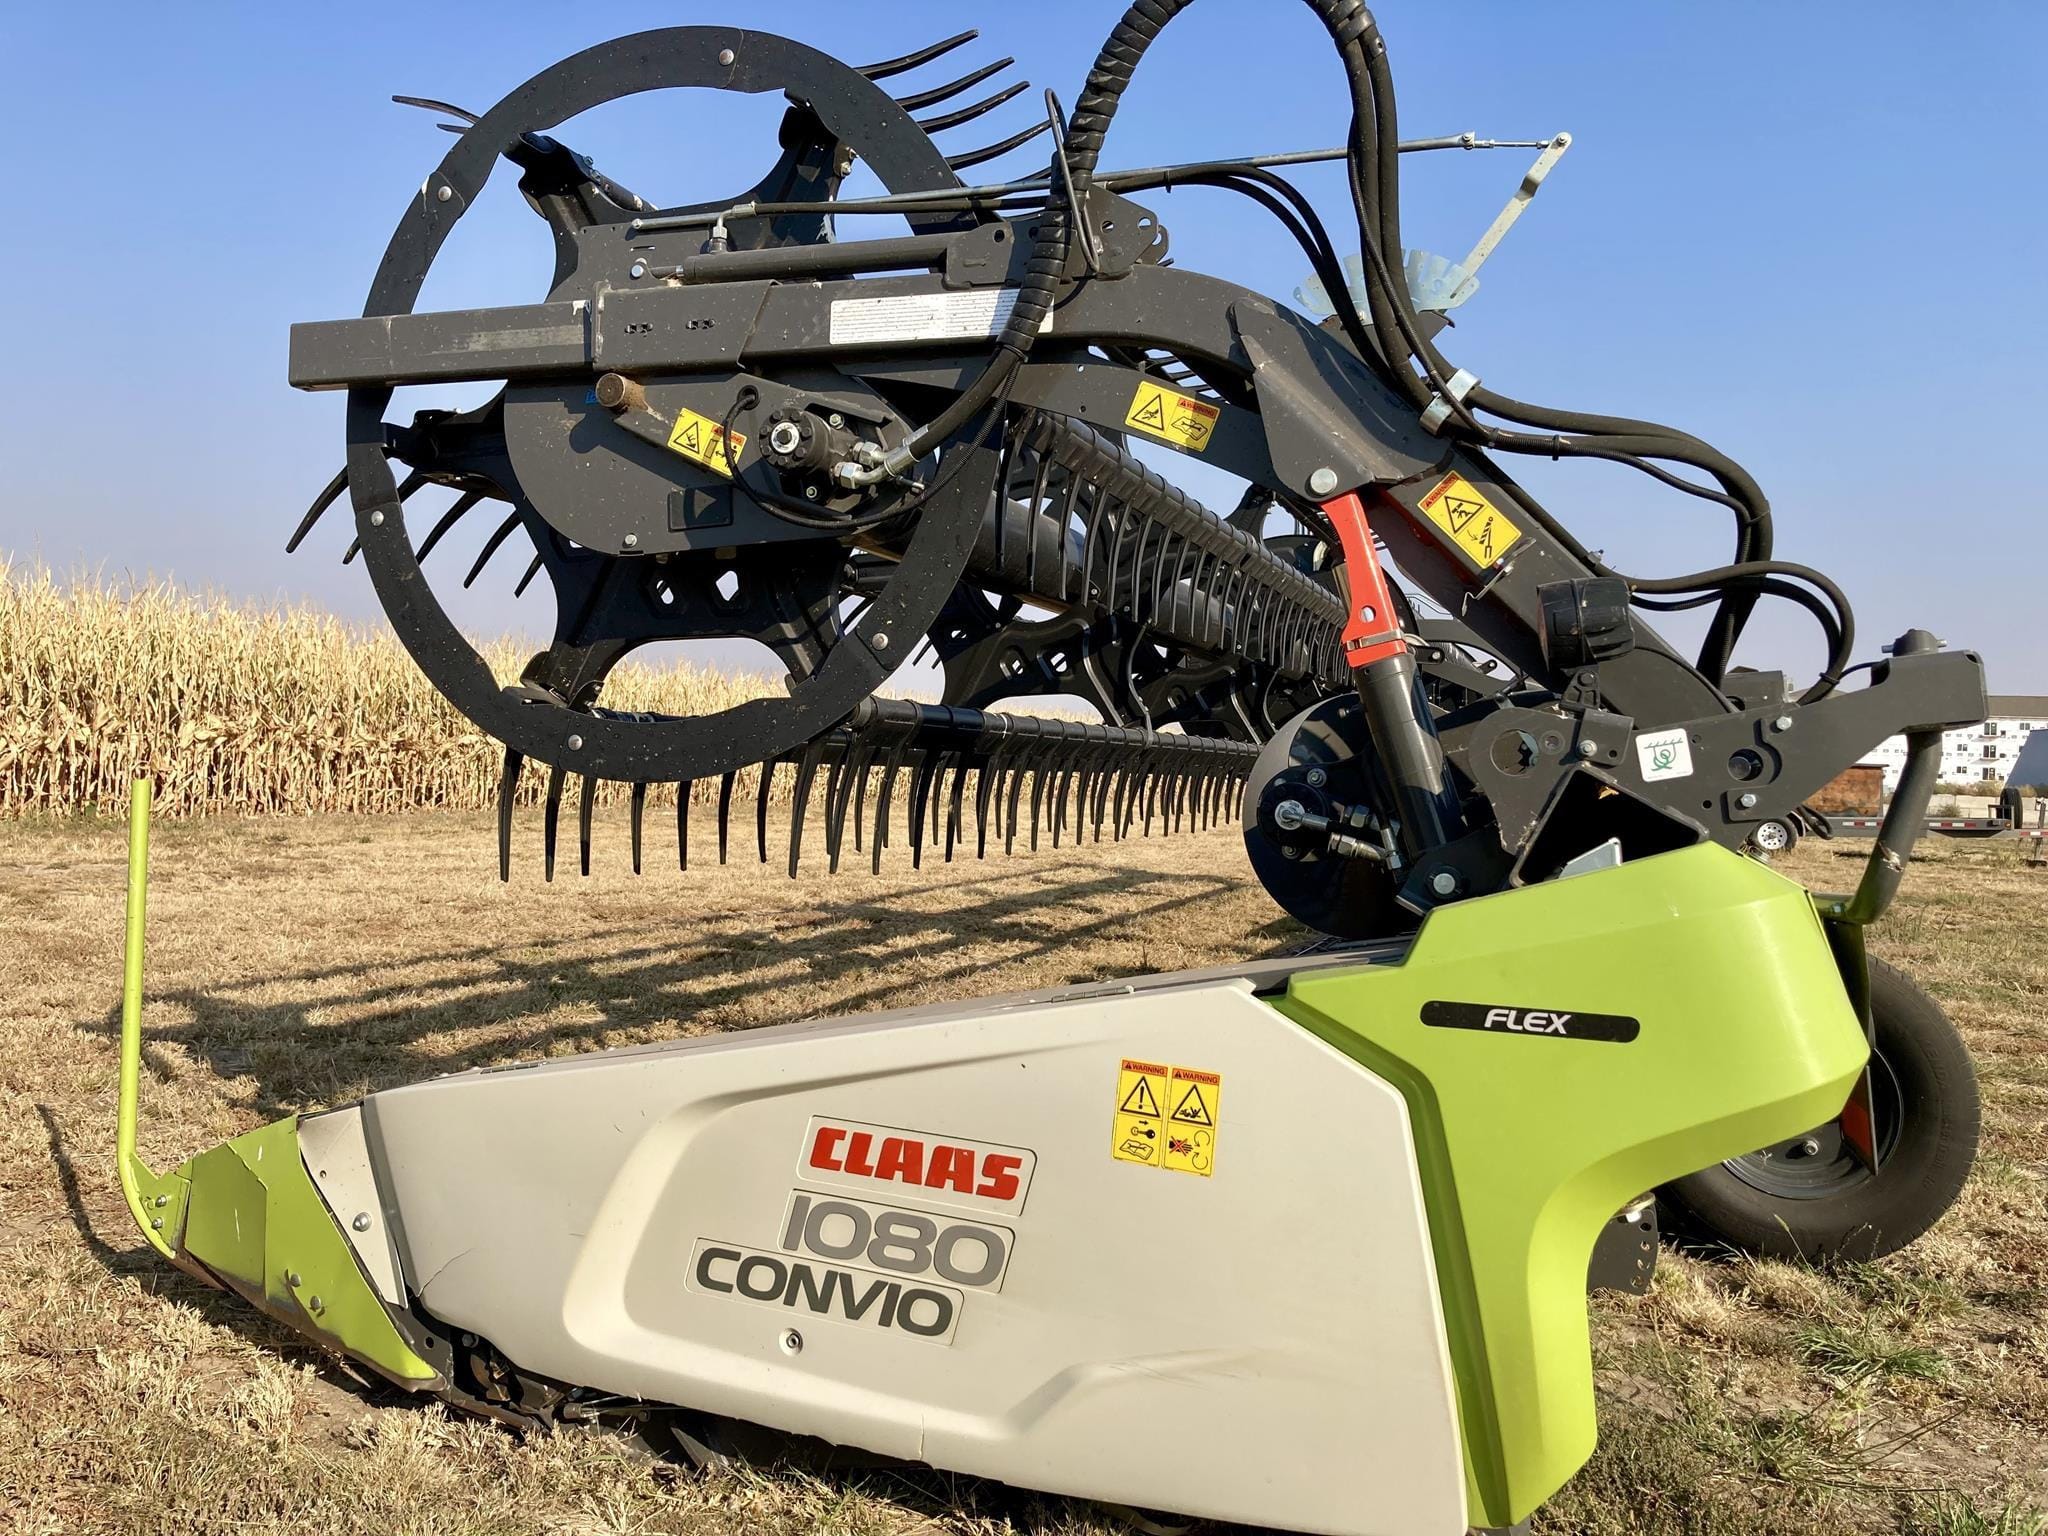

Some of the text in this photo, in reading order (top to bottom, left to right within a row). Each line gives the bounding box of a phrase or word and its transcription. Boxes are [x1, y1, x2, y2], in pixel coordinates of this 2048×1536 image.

[1484, 1008, 1572, 1035] FLEX
[1132, 1063, 1165, 1075] WARNING
[1182, 1072, 1218, 1084] WARNING
[809, 1127, 1023, 1201] CLAAS
[783, 1195, 1006, 1286] 1080
[696, 1247, 953, 1337] CONVIO
